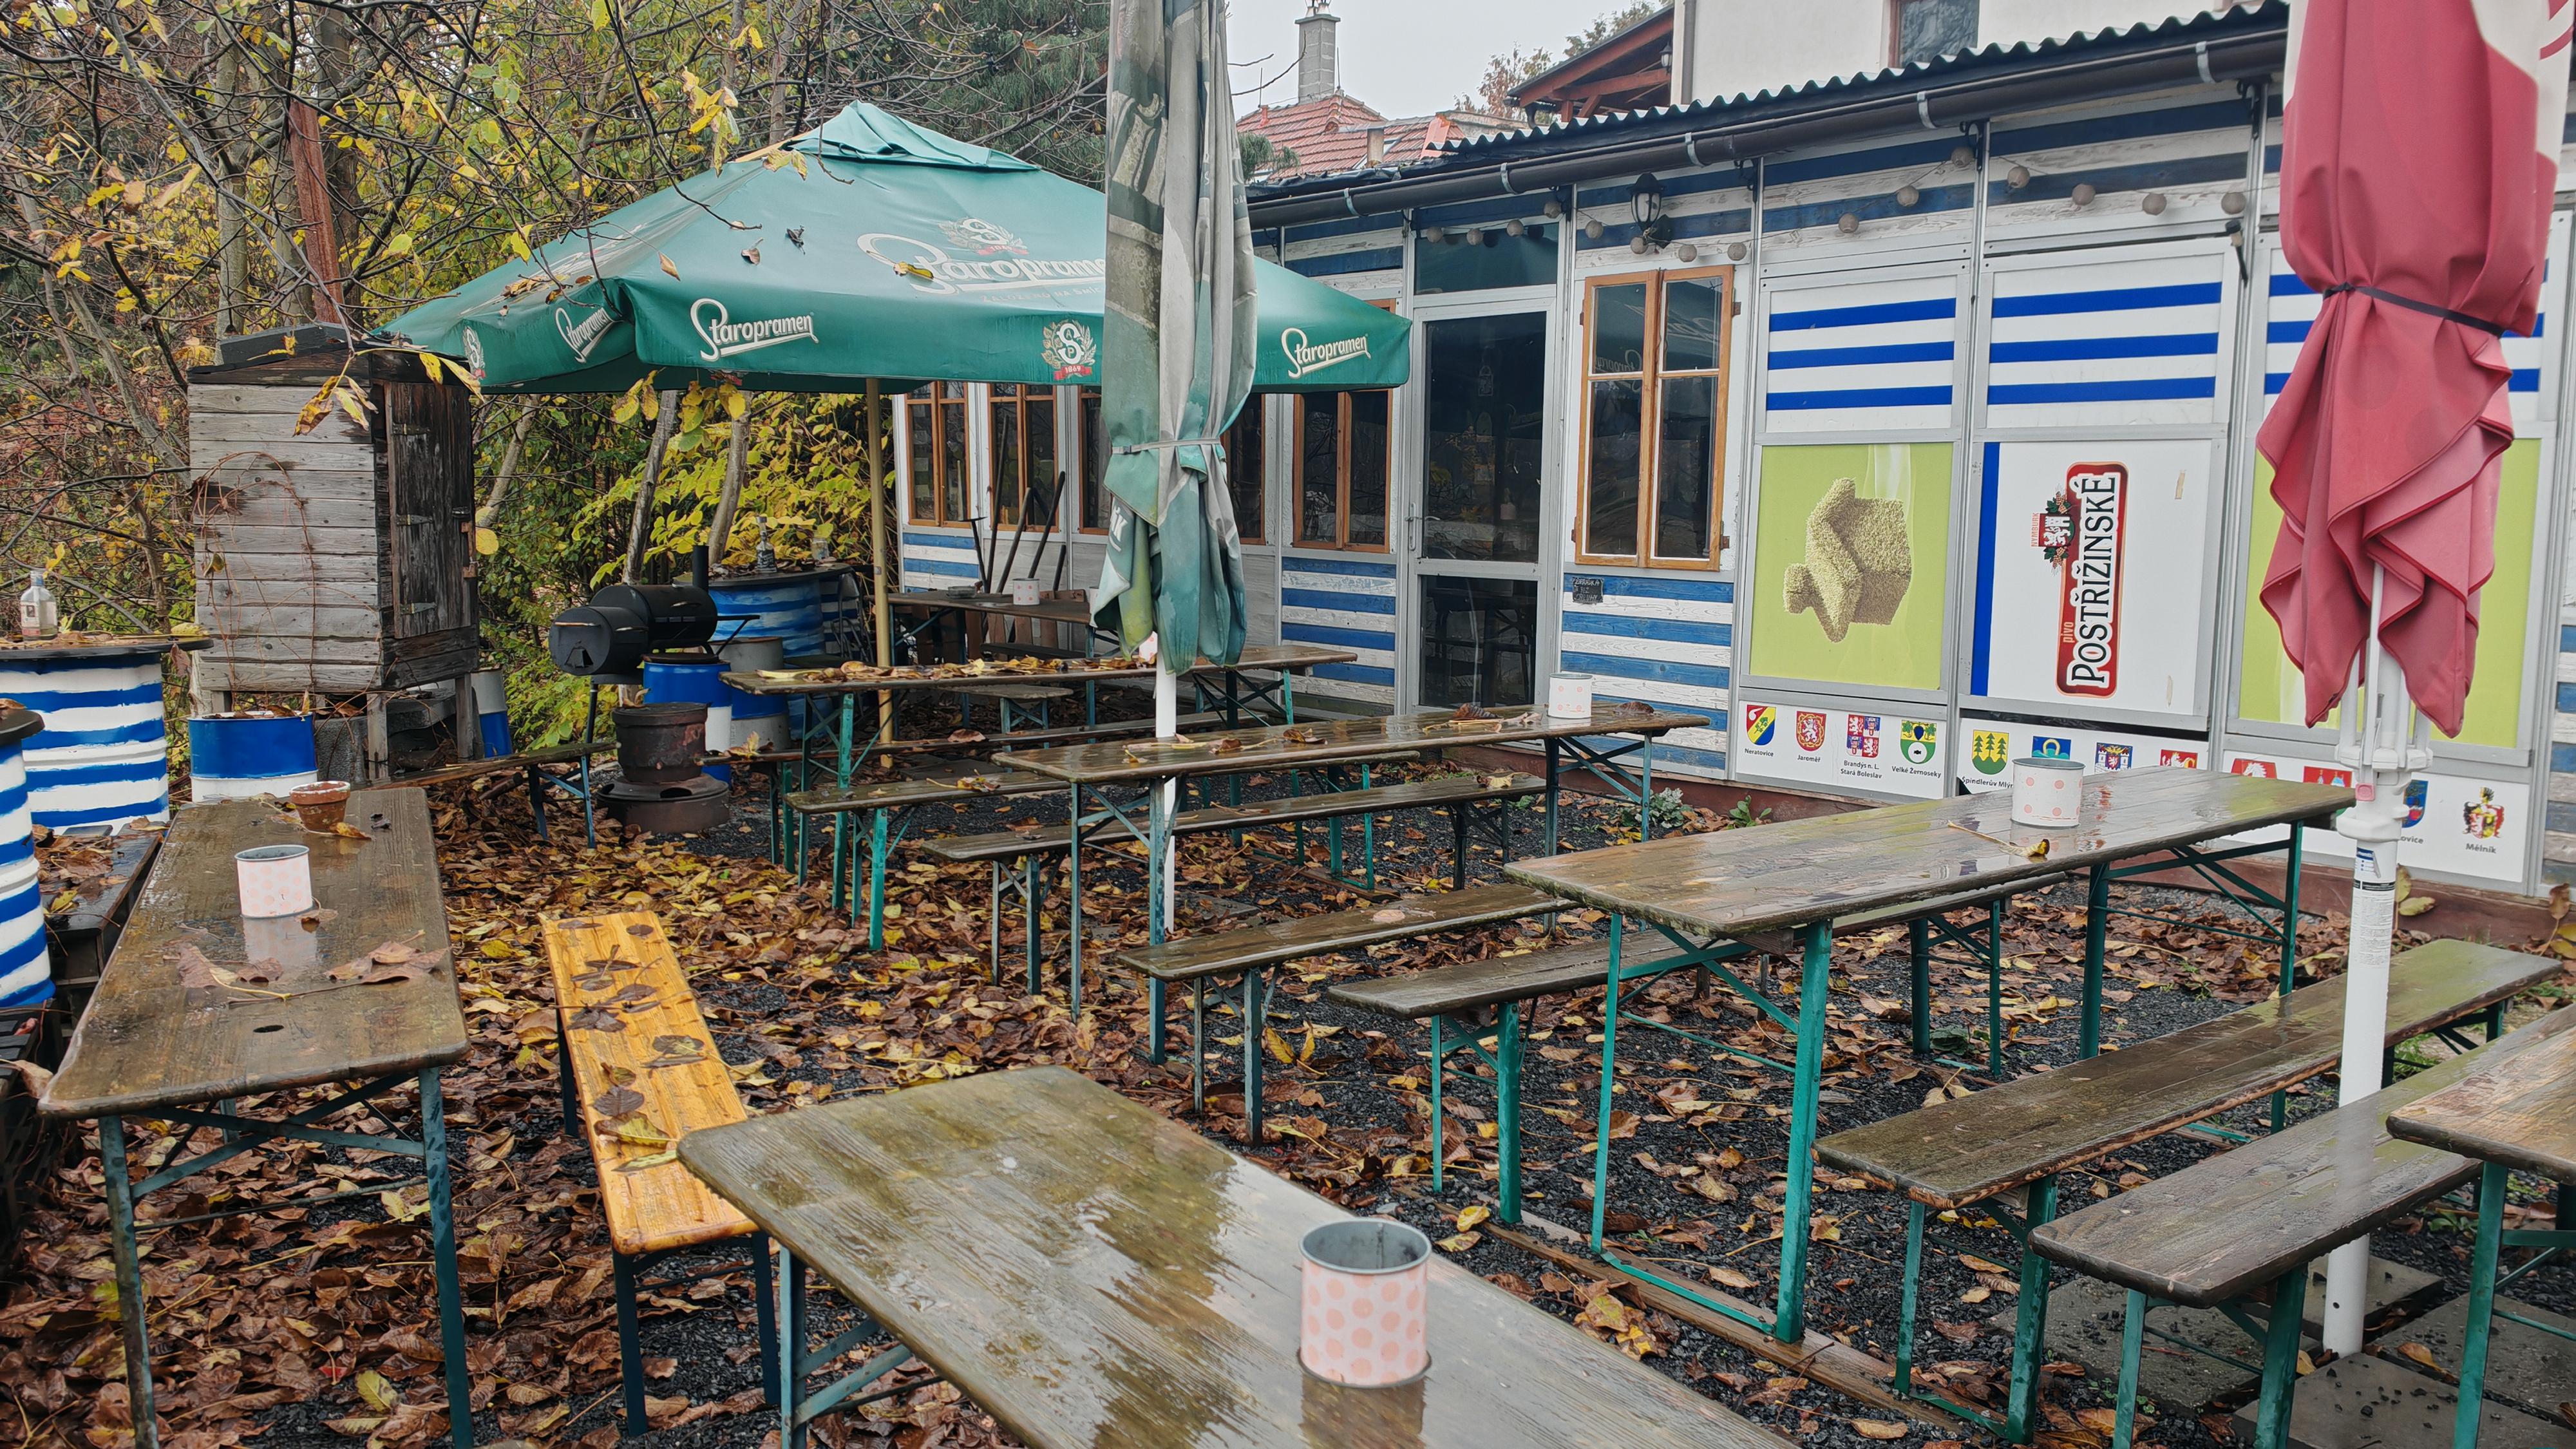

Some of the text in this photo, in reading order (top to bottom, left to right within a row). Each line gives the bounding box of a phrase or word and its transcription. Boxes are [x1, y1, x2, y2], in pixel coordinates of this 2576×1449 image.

[857, 232, 1106, 294] Staroprame
[554, 307, 624, 364] Staropramen
[690, 298, 819, 363] Staropramen
[1280, 327, 1372, 379] Staropramen
[1065, 365, 1081, 374] 1869
[2031, 512, 2040, 547] NYMBURK
[2070, 477, 2116, 683] POSTŘIŽINSKÉ
[2063, 621, 2074, 643] pivo
[1744, 748, 1774, 757] Neratovice
[1843, 760, 1867, 769] Brandýs
[1857, 770, 1882, 779] Boleslav
[1909, 766, 1942, 779] Žernoseky
[1962, 775, 1997, 784] Špindlerův
